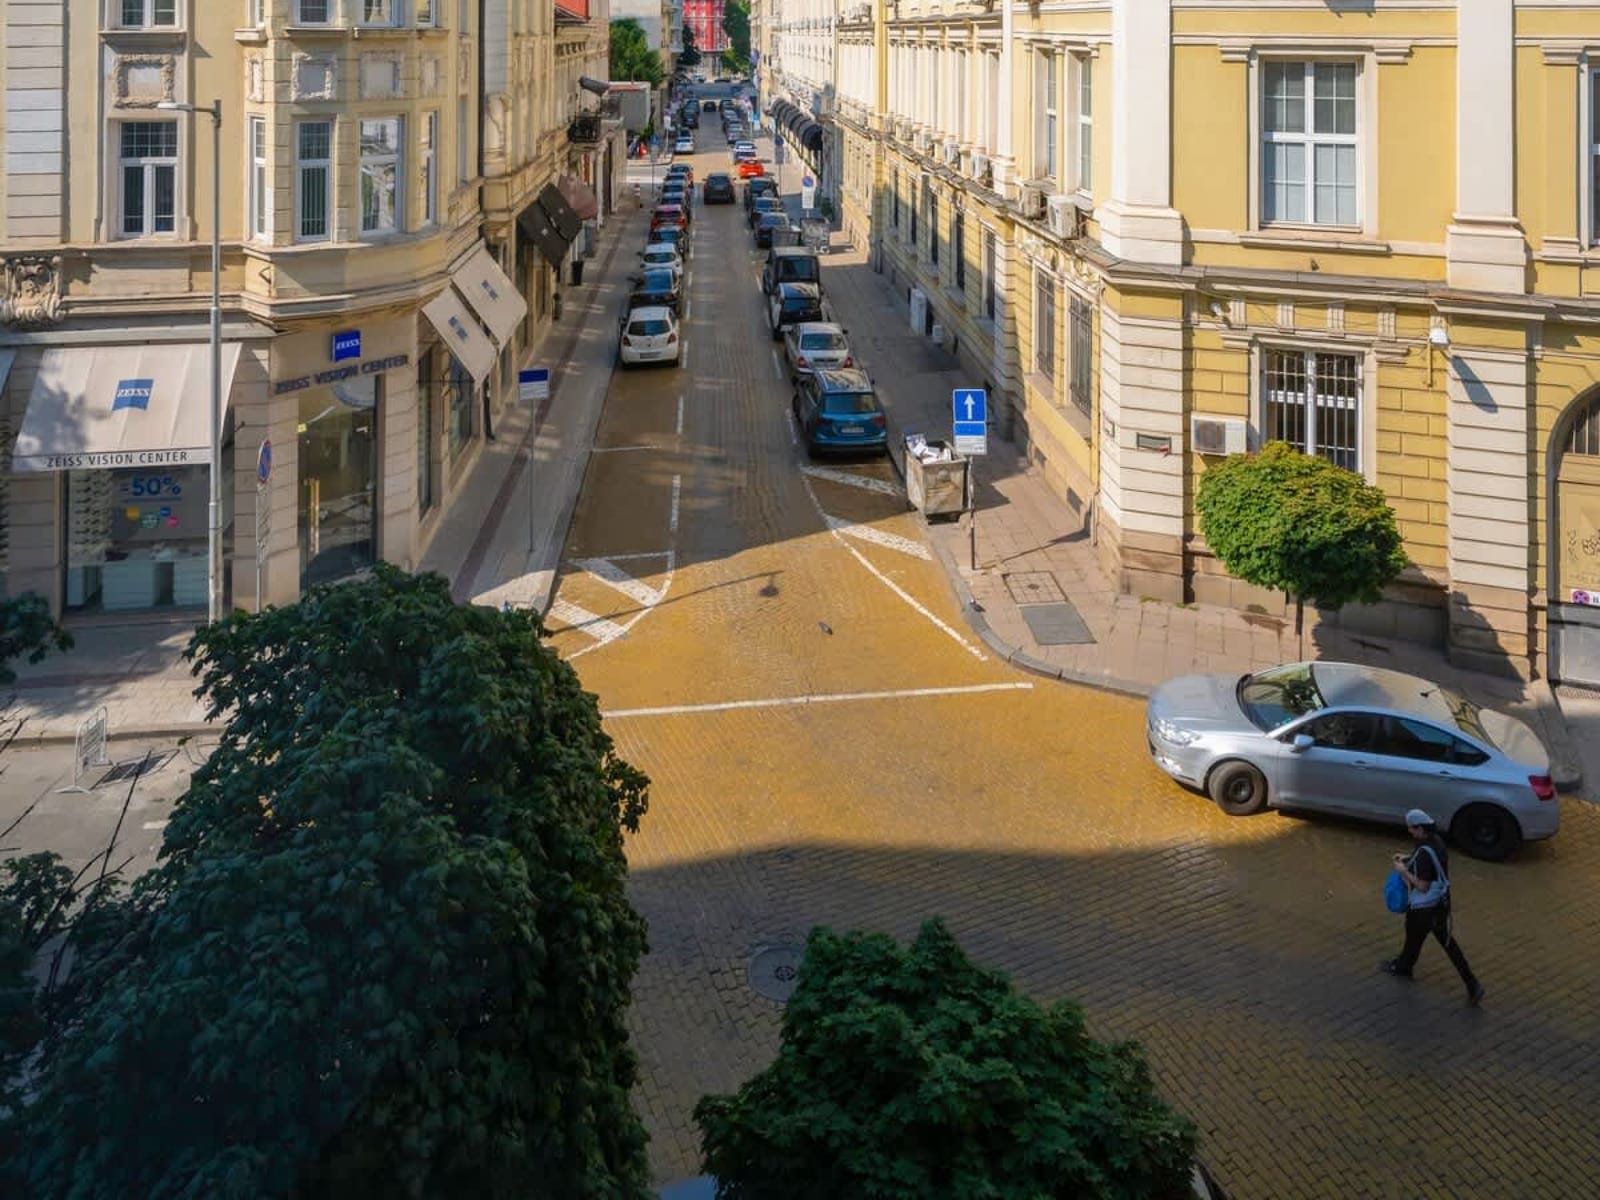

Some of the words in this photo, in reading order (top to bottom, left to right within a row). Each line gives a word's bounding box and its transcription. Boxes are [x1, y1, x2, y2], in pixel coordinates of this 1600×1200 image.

[47, 456, 82, 467] ZEISS
[88, 454, 133, 465] VISION
[139, 451, 188, 463] CENTER
